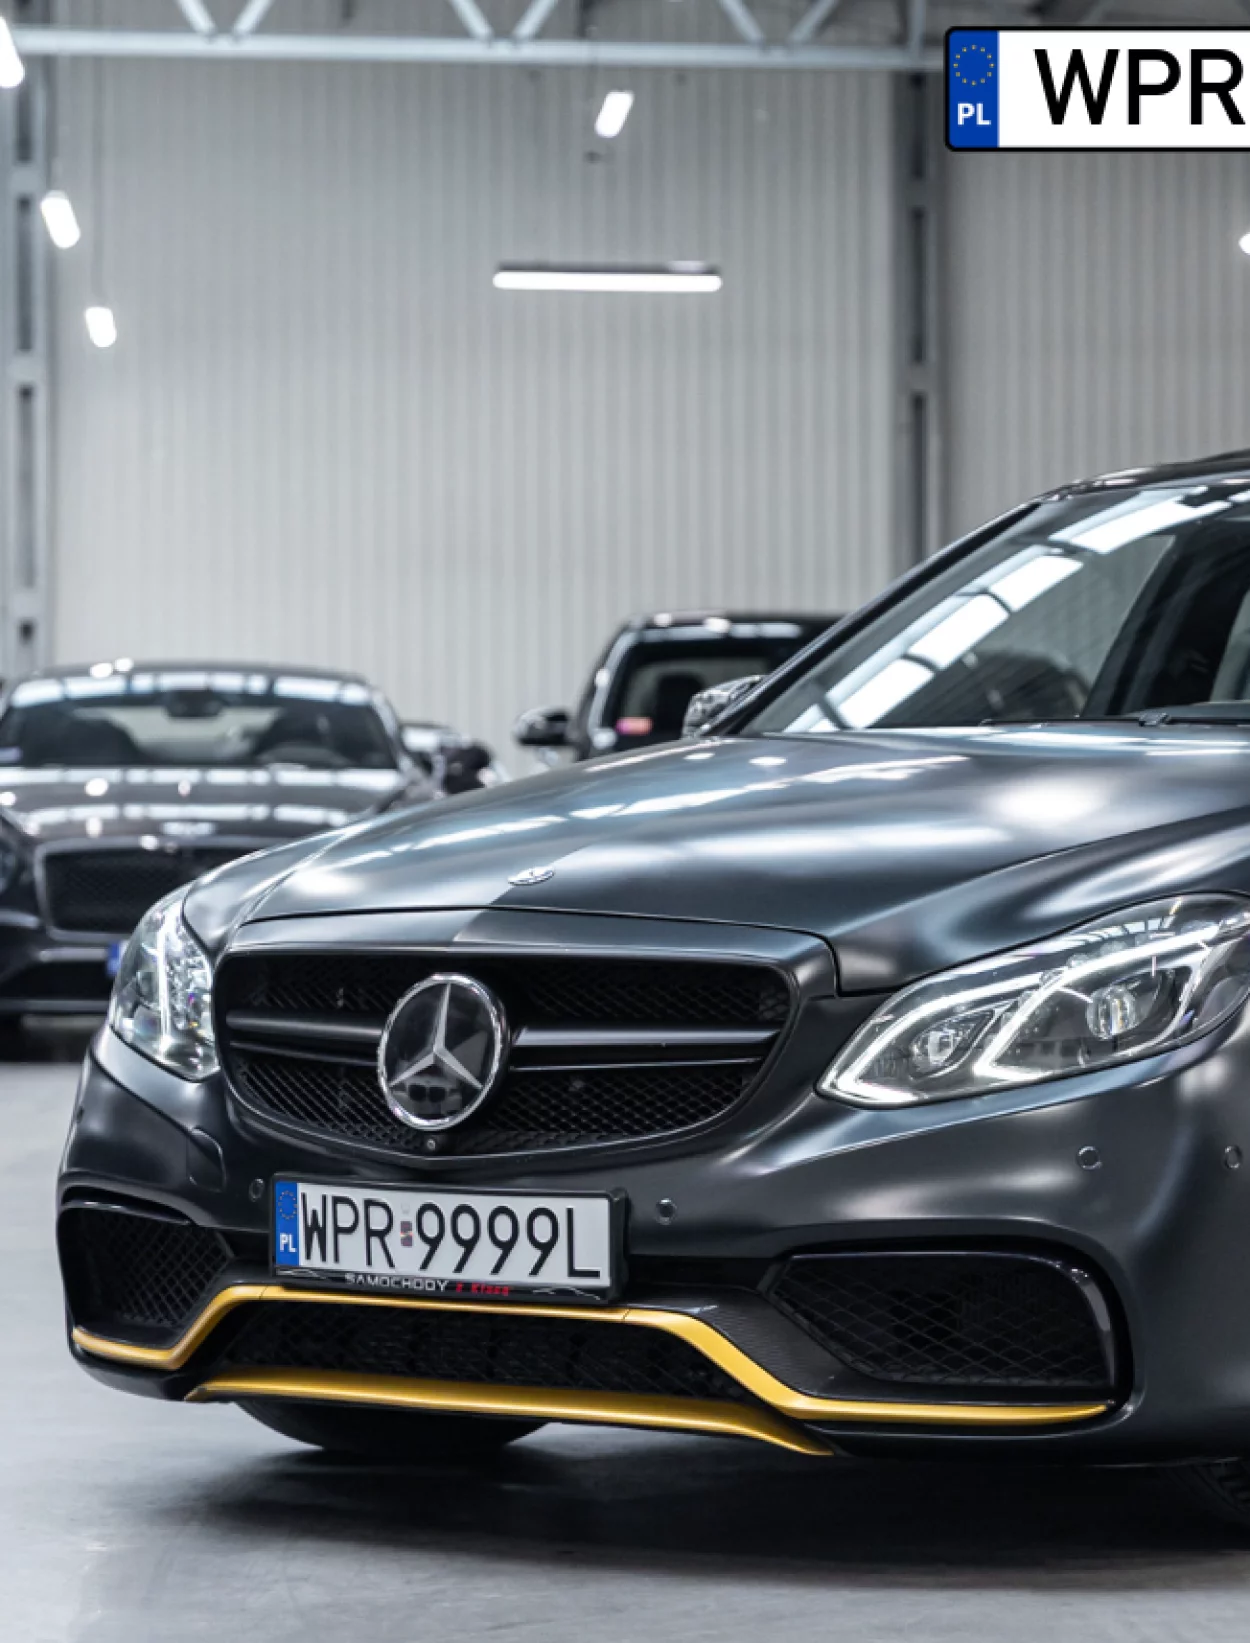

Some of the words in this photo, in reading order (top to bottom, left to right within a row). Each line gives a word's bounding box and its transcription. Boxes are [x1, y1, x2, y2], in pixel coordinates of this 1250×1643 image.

[279, 1233, 297, 1254] PL
[301, 1192, 395, 1269] WPR
[416, 1201, 600, 1278] 9999L
[344, 1273, 449, 1291] SAMOCHODY
